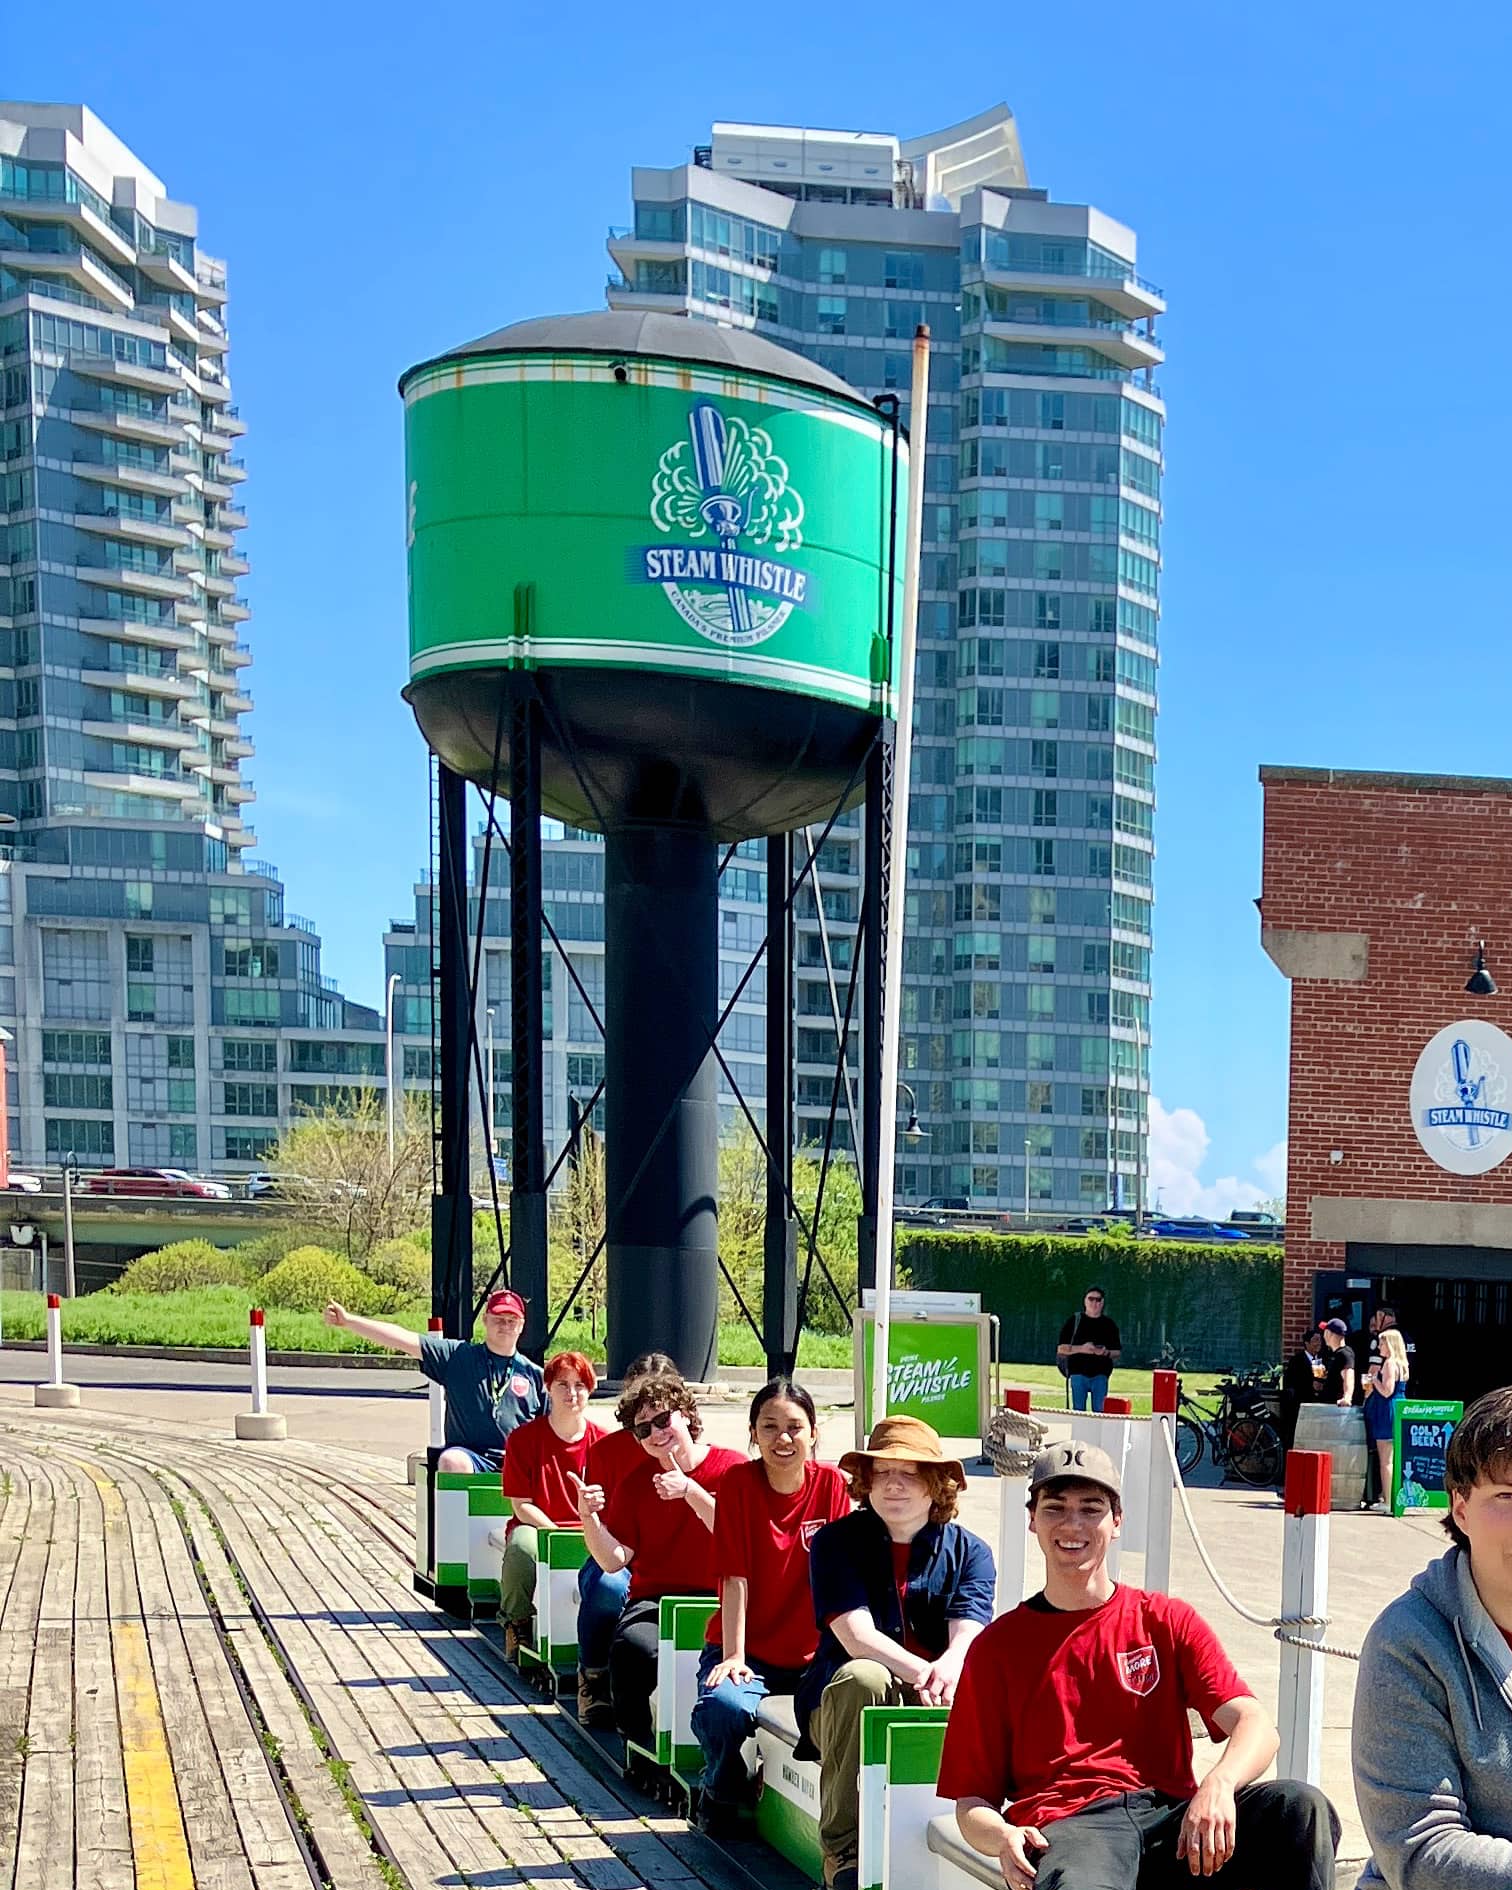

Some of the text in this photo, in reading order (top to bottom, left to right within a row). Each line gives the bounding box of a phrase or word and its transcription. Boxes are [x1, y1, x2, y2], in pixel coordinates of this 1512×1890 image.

[646, 549, 807, 602] STEAM WHISTLE
[1430, 1109, 1463, 1125] STEAM
[889, 1369, 972, 1404] WHISTLE
[1410, 1424, 1441, 1437] COLD
[1125, 1655, 1152, 1675] MORE
